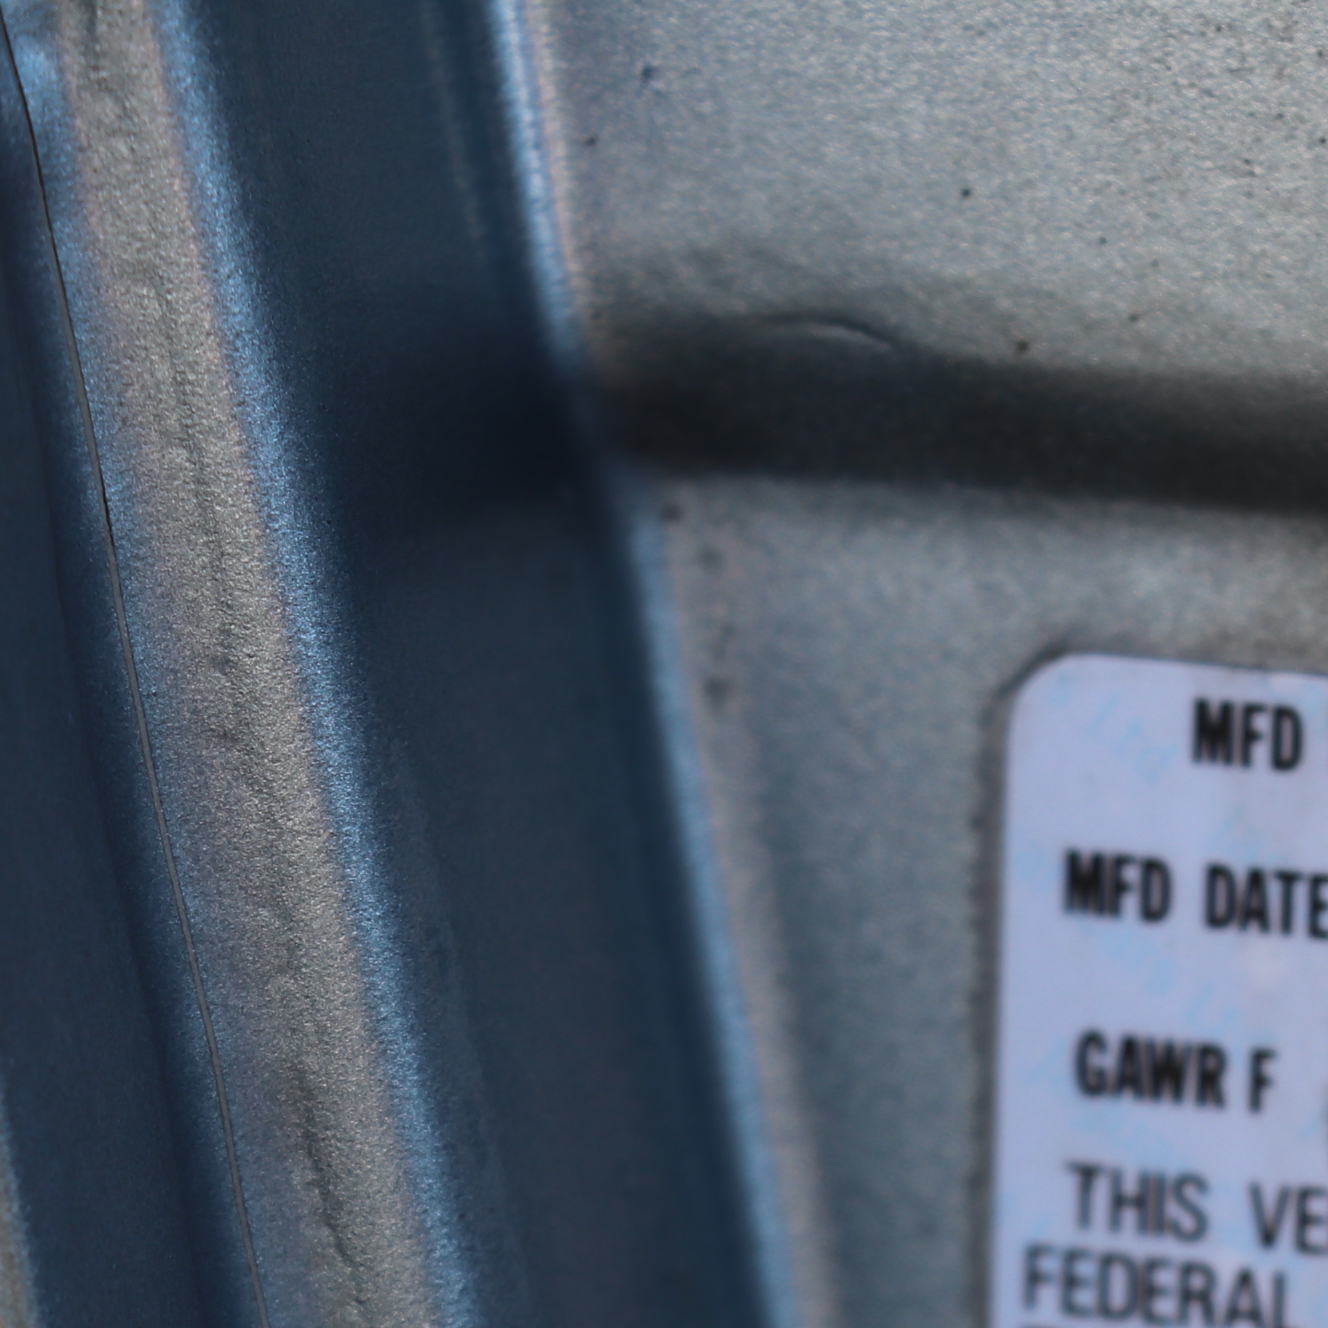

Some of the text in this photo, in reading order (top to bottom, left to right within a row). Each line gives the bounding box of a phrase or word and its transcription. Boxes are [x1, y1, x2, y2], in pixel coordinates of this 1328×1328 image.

[1193, 698, 1302, 771] MFD
[1065, 849, 1171, 923] MFD
[1075, 1032, 1277, 1114] GAWR F
[1069, 1162, 1210, 1245] THIS
